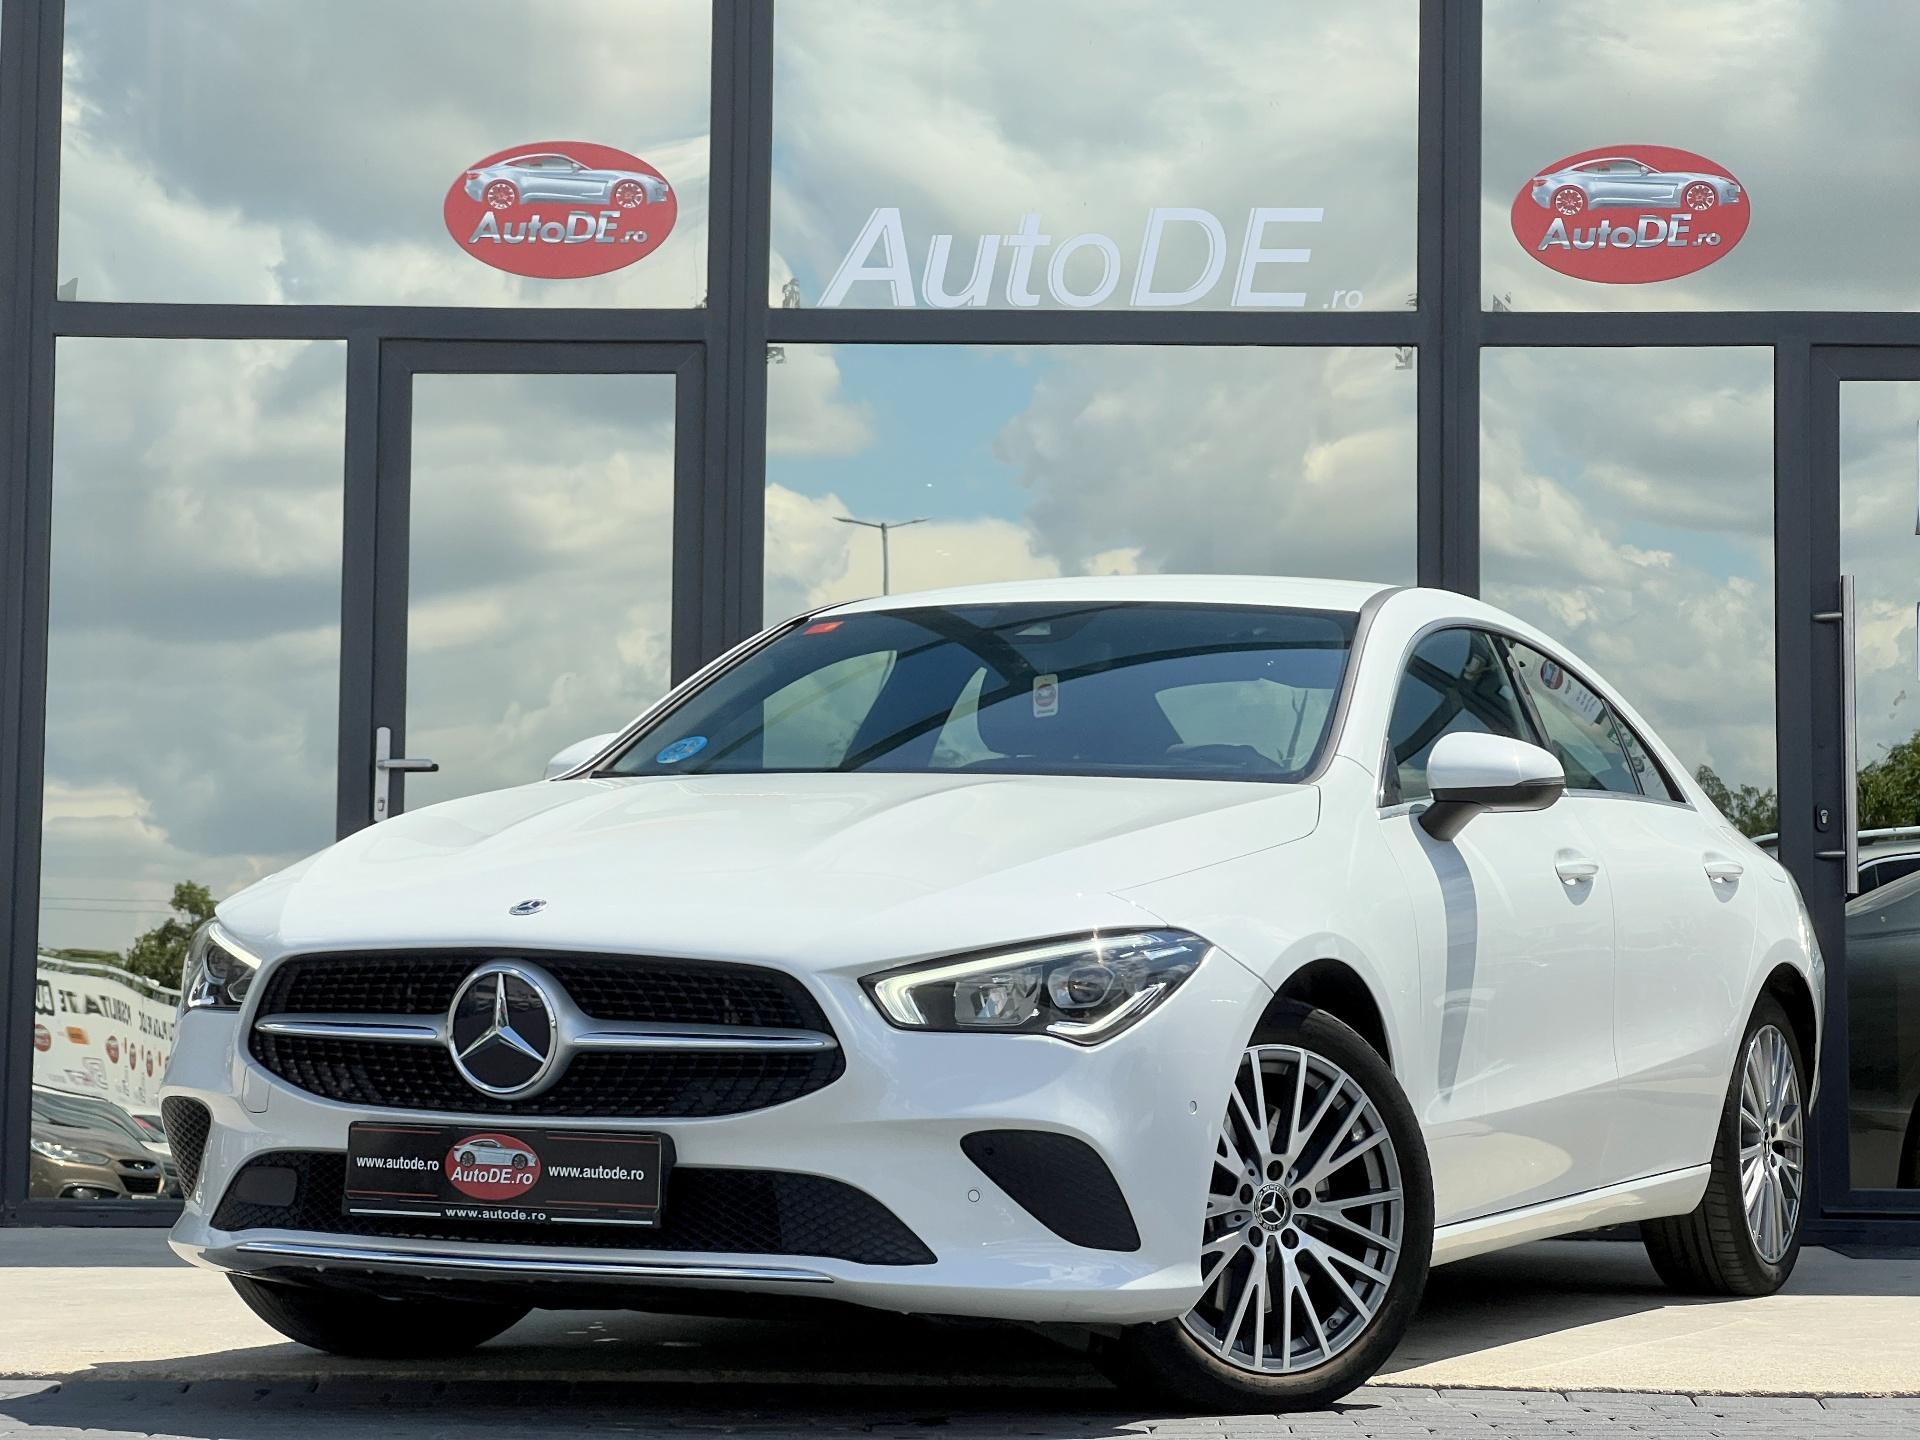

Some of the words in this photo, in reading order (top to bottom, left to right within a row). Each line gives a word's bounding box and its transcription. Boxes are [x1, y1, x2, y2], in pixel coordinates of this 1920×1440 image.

[469, 211, 620, 244] AutoDE
[1538, 214, 1691, 250] AutoDE
[817, 207, 1324, 308] AutoDE
[356, 1155, 439, 1171] www.autode.ro
[548, 1164, 645, 1182] www.autode.ro
[450, 1166, 534, 1186] AutoDE.ro
[445, 1207, 547, 1222] www.autode.ro
